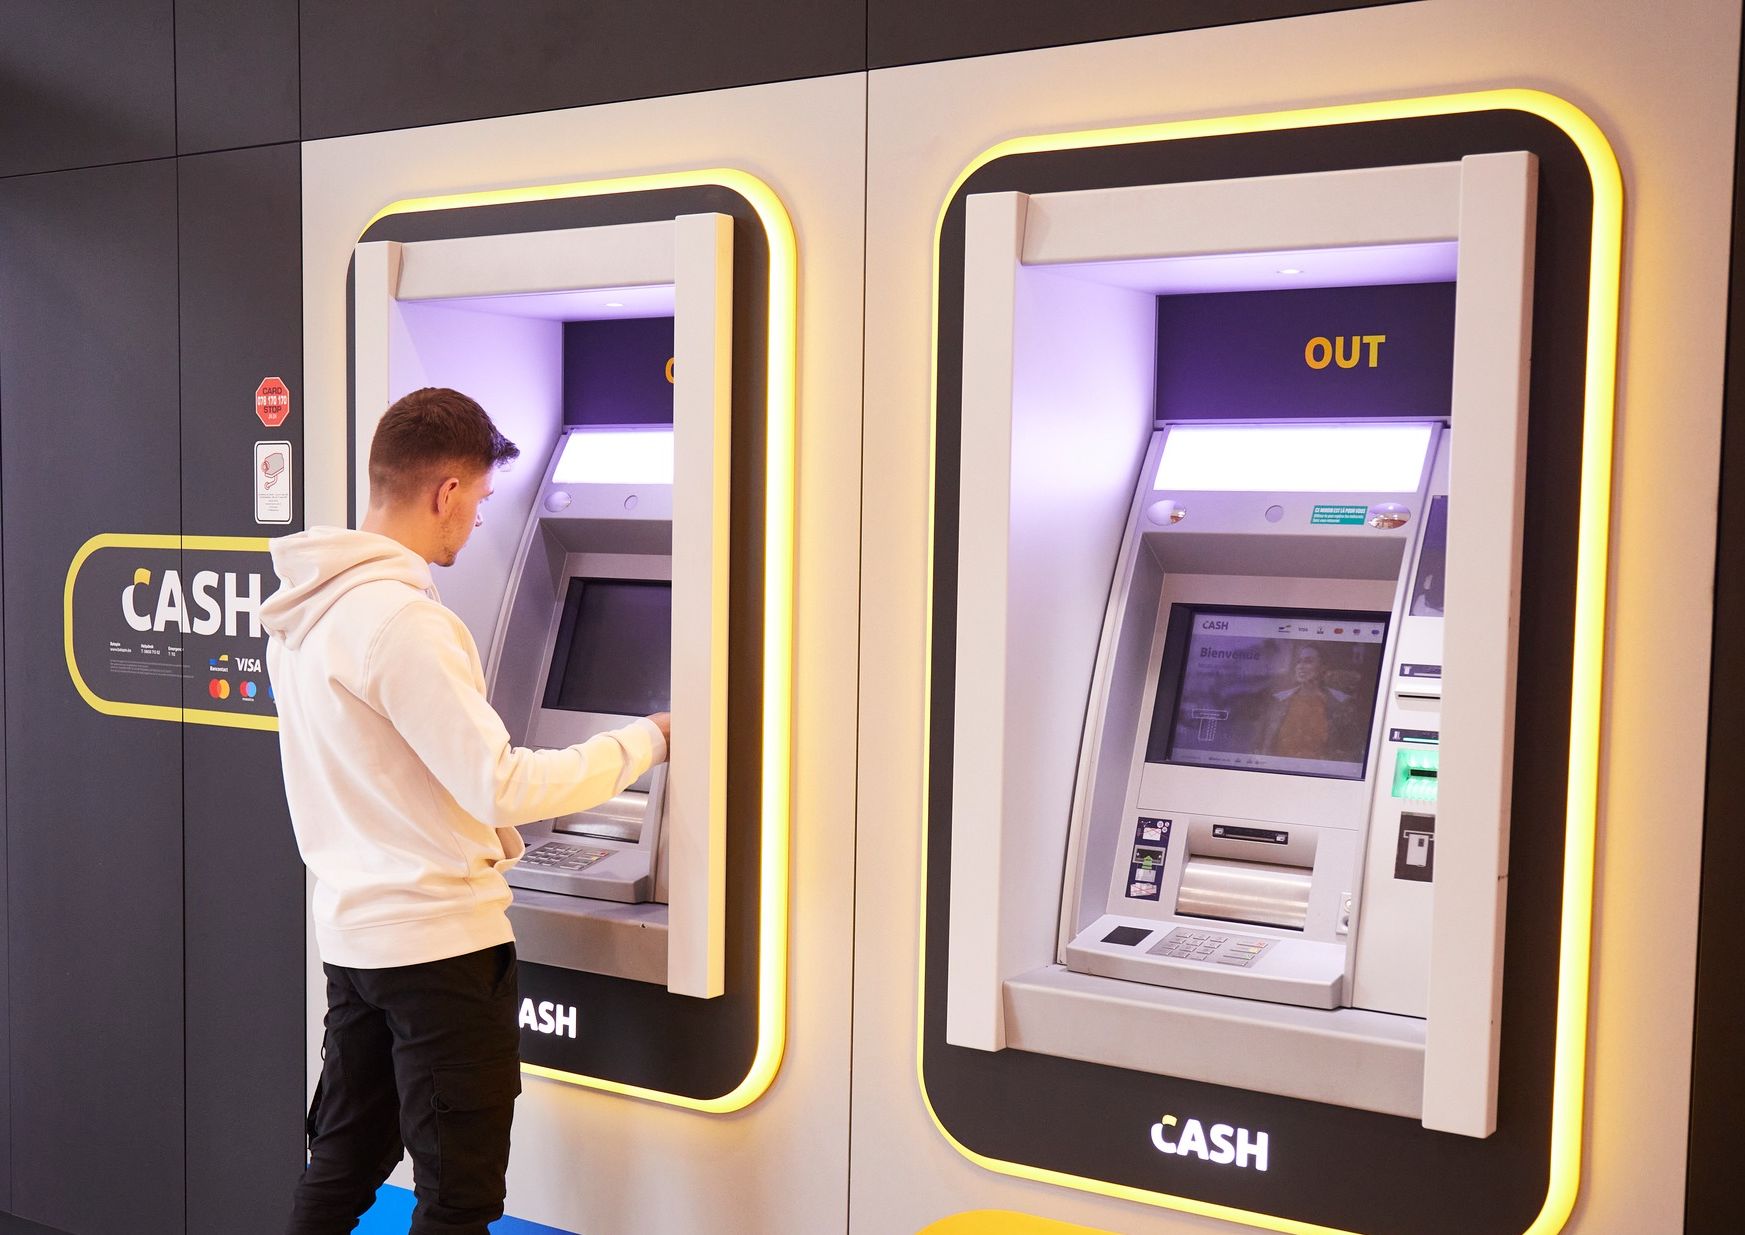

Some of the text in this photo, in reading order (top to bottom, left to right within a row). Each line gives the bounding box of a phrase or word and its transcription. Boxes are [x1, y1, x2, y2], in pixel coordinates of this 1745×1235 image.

[1305, 335, 1386, 370] OUT
[122, 567, 261, 638] CASH
[1202, 620, 1229, 631] CASH
[235, 657, 262, 673] VISA
[1200, 648, 1260, 660] Bienvenue
[518, 997, 577, 1039] ASH
[1150, 1114, 1269, 1172] CASH
